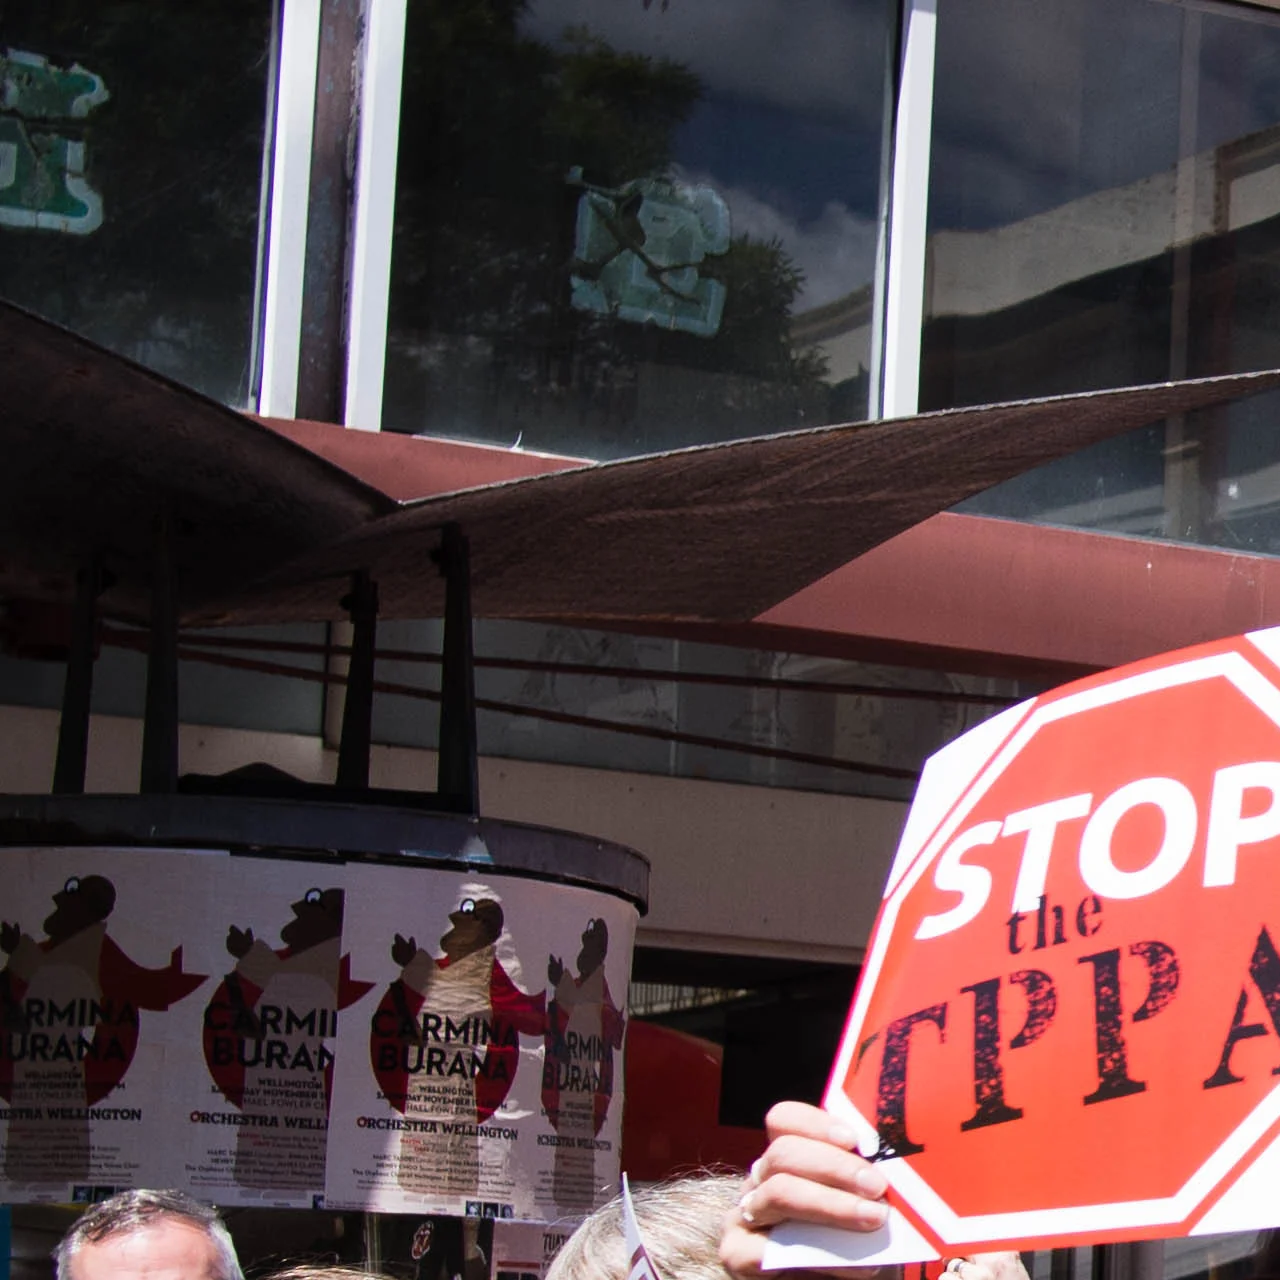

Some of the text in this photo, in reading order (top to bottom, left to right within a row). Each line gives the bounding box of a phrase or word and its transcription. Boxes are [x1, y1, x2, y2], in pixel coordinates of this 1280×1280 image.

[1006, 893, 1103, 955] the
[204, 1001, 338, 1038] CARMI
[371, 1009, 519, 1048] CARMINA
[0, 1031, 125, 1062] URANA
[213, 1036, 336, 1073] BURAN
[378, 1043, 509, 1082] BURANA
[47, 1107, 142, 1121] WELLINGTON
[189, 1109, 279, 1127] ORCHESTRA
[356, 1116, 519, 1141] ORCHESTRA WELLINGTON
